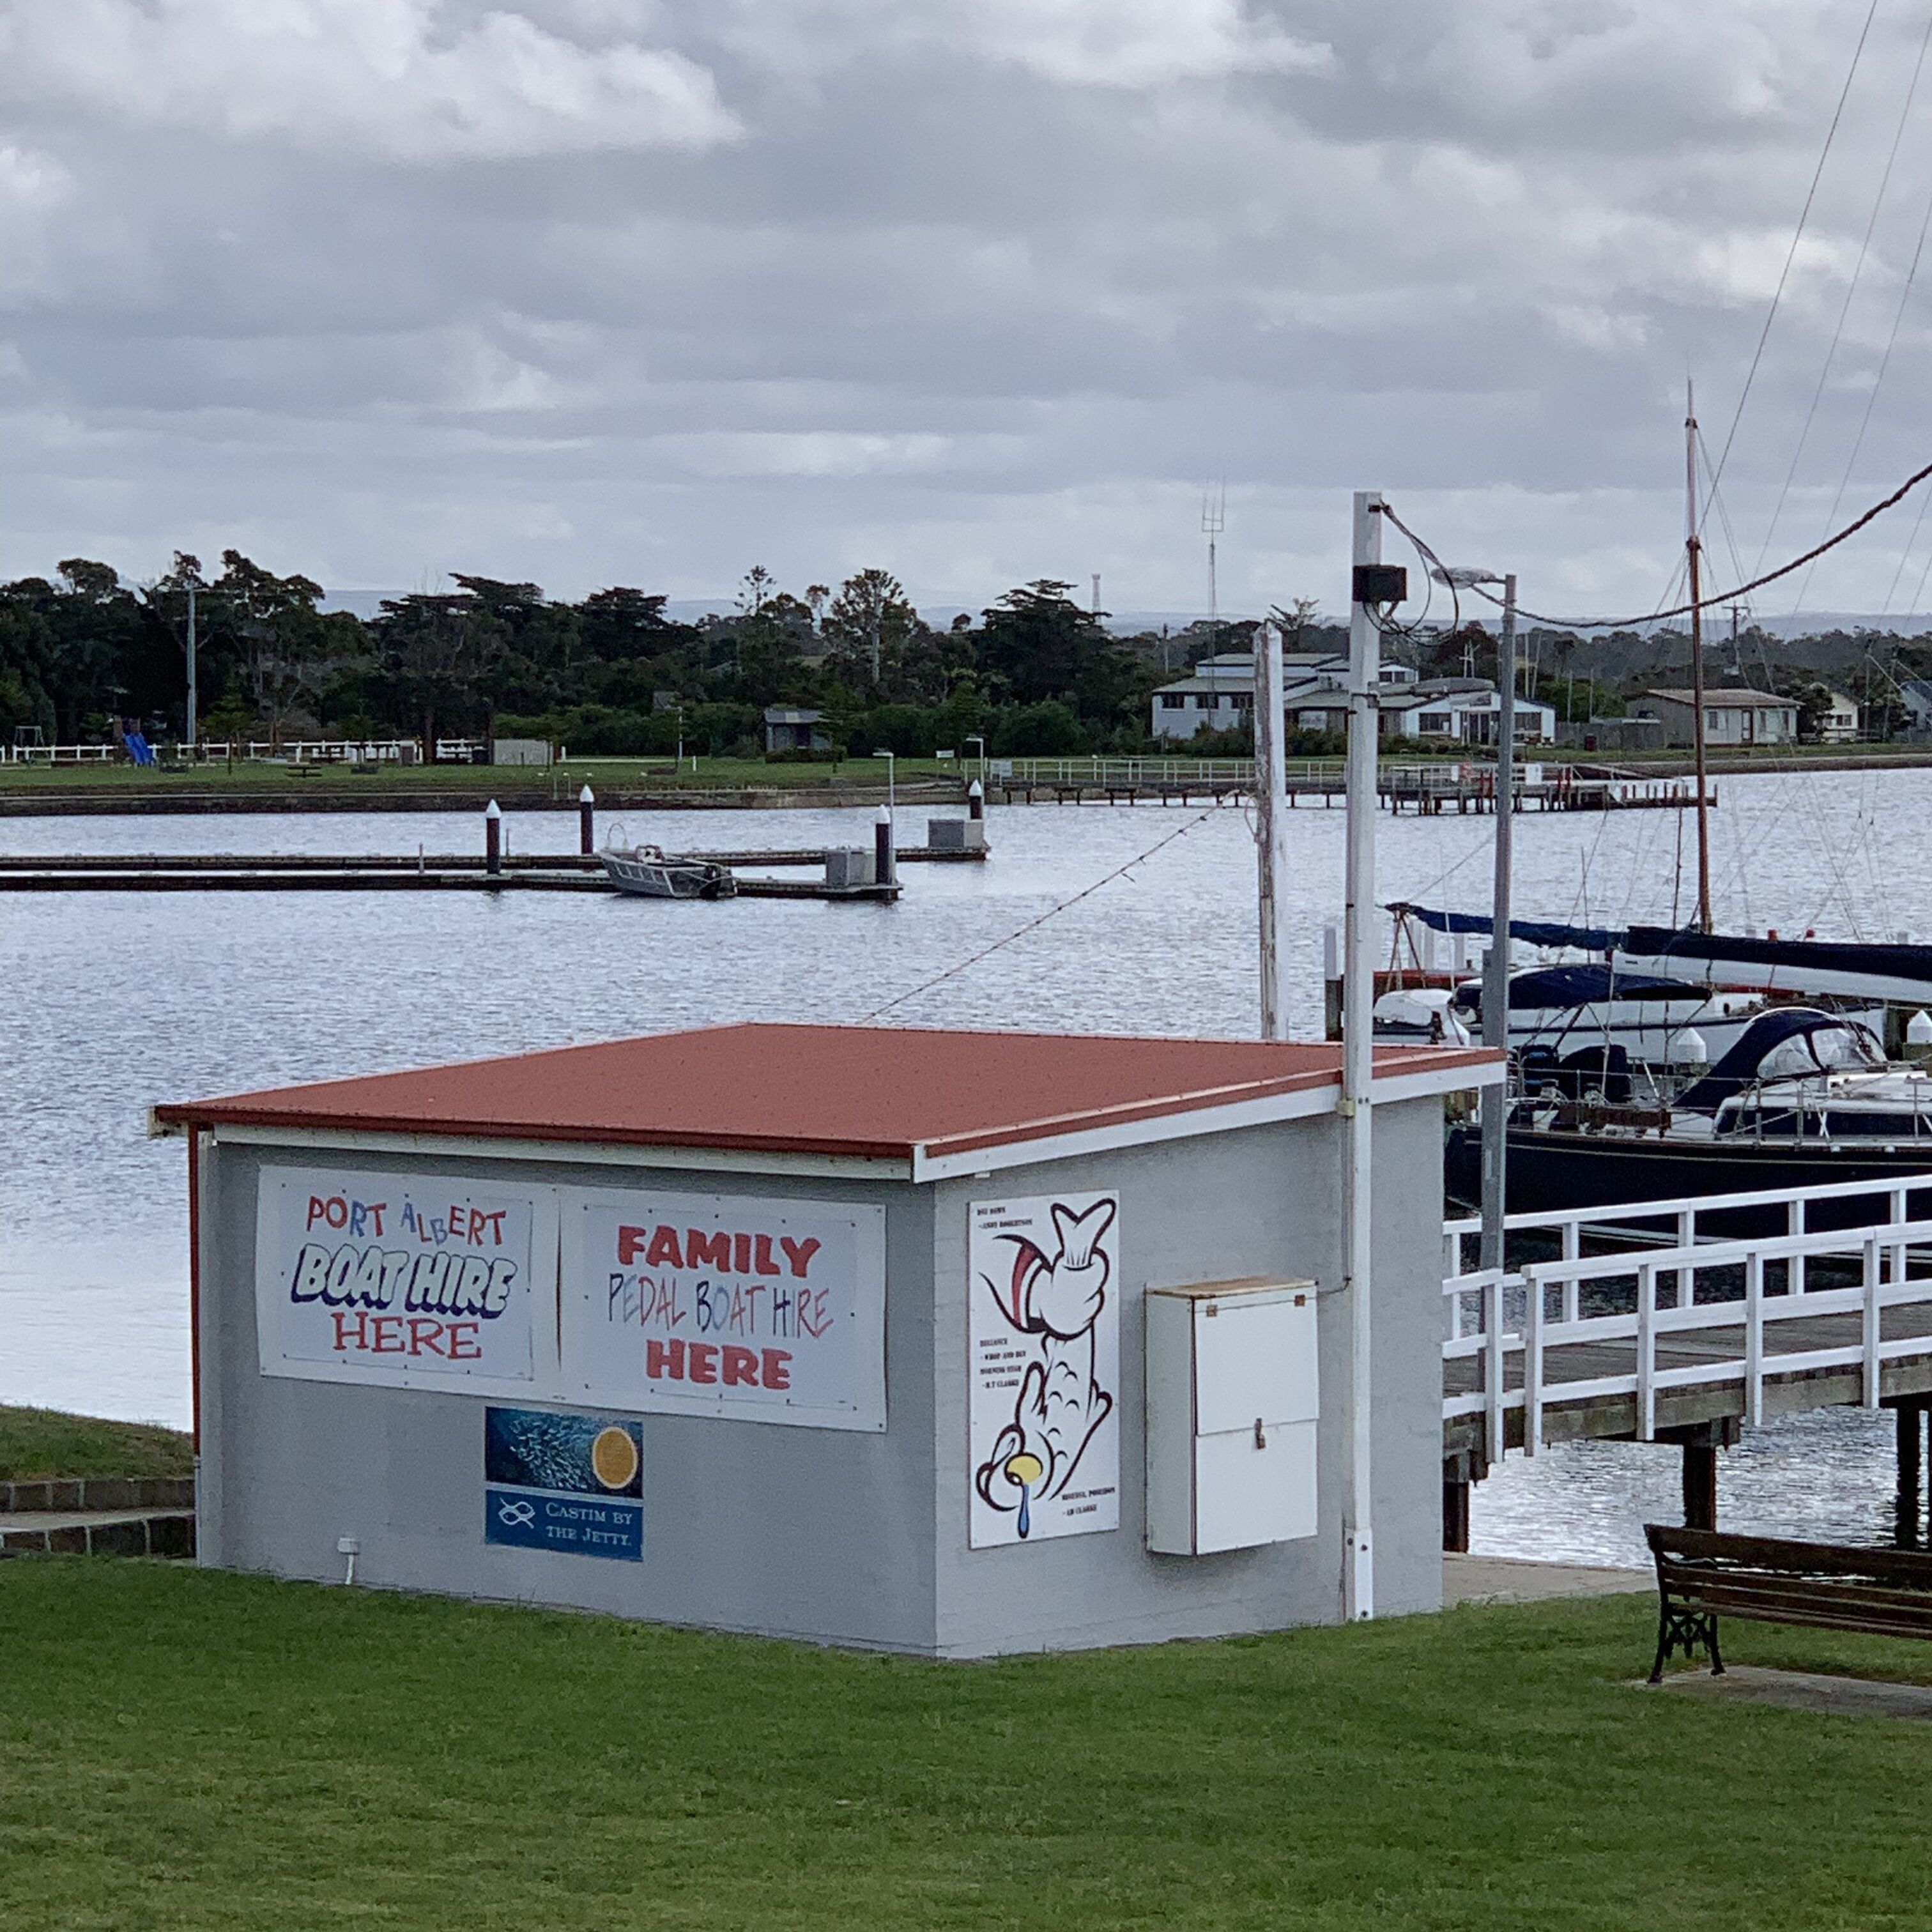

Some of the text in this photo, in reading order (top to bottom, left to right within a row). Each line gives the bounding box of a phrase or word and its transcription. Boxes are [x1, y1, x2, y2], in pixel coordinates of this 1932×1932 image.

[307, 1195, 507, 1246] PORT ALBERT
[618, 1225, 822, 1278] FAMILY
[291, 1243, 518, 1319] BOAT HIRE
[609, 1273, 834, 1339] PEDAL BOAT HIRE
[331, 1311, 482, 1360] HERE
[646, 1338, 793, 1391] HERE
[546, 1525, 576, 1540] THE
[612, 1512, 632, 1526] BY
